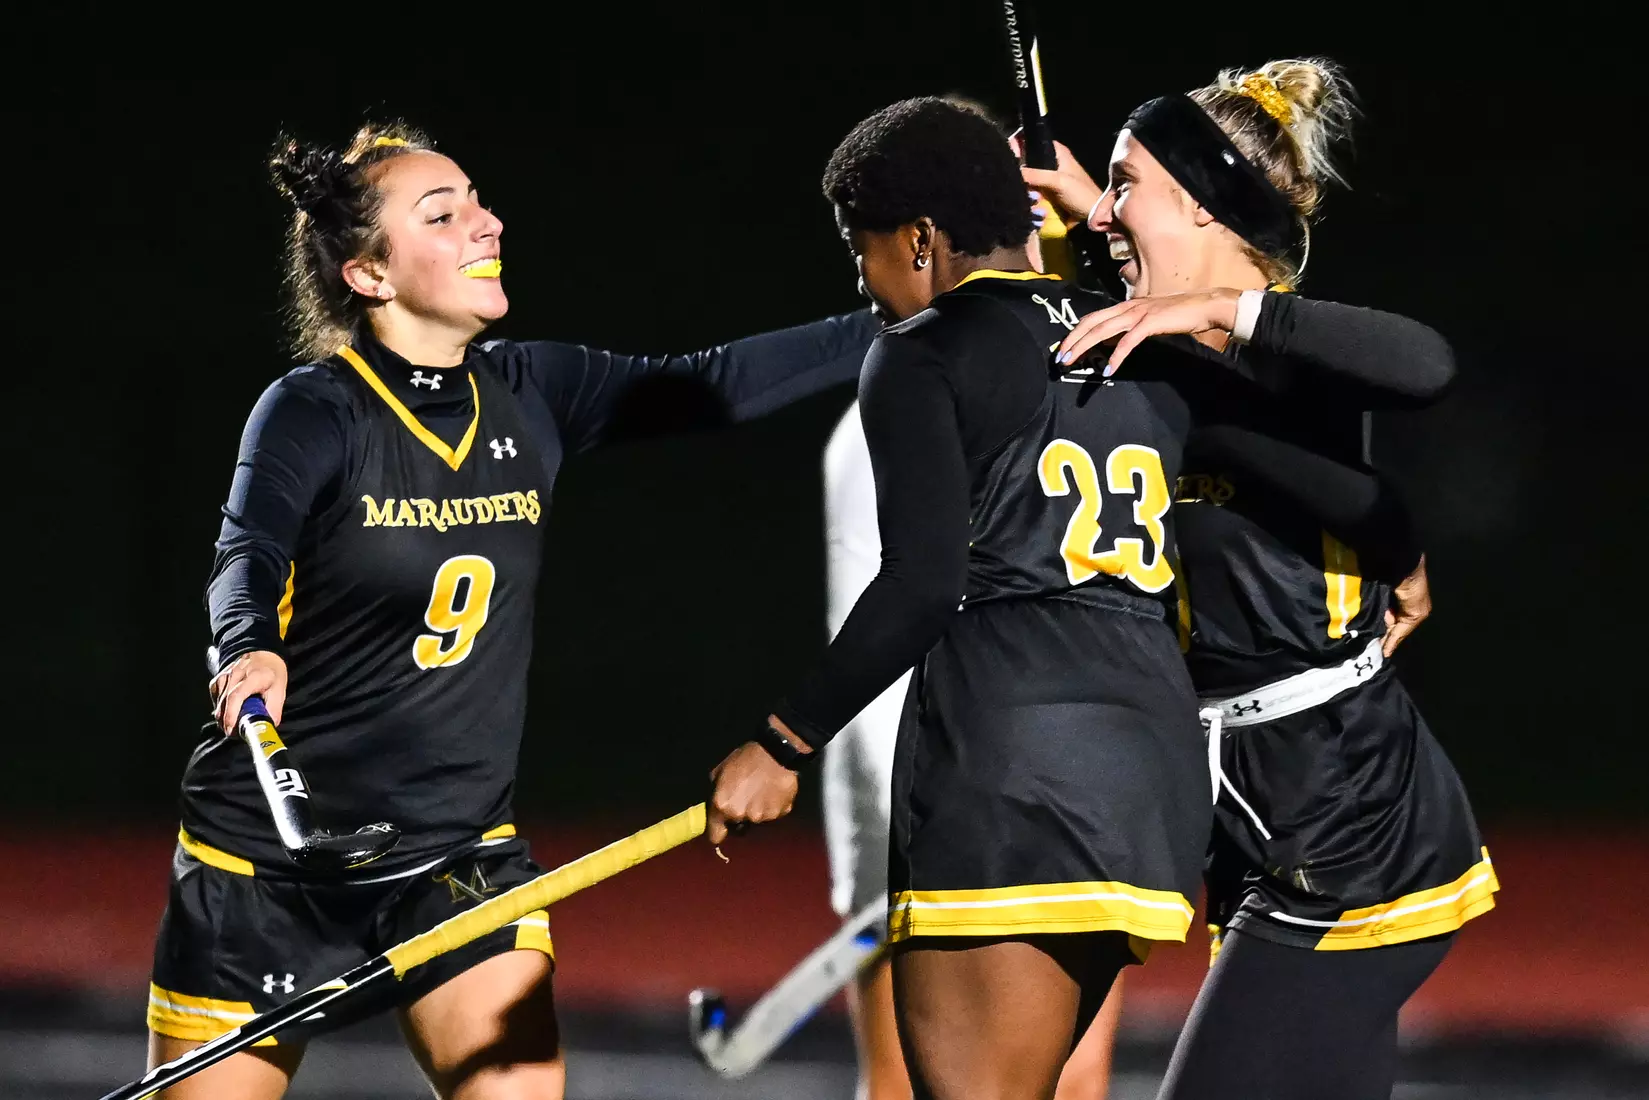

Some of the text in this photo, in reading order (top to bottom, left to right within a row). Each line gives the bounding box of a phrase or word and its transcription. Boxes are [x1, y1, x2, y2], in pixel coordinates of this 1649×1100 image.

[361, 490, 541, 532] MARAUDERS
[1037, 438, 1175, 593] 23
[412, 554, 496, 671] 9
